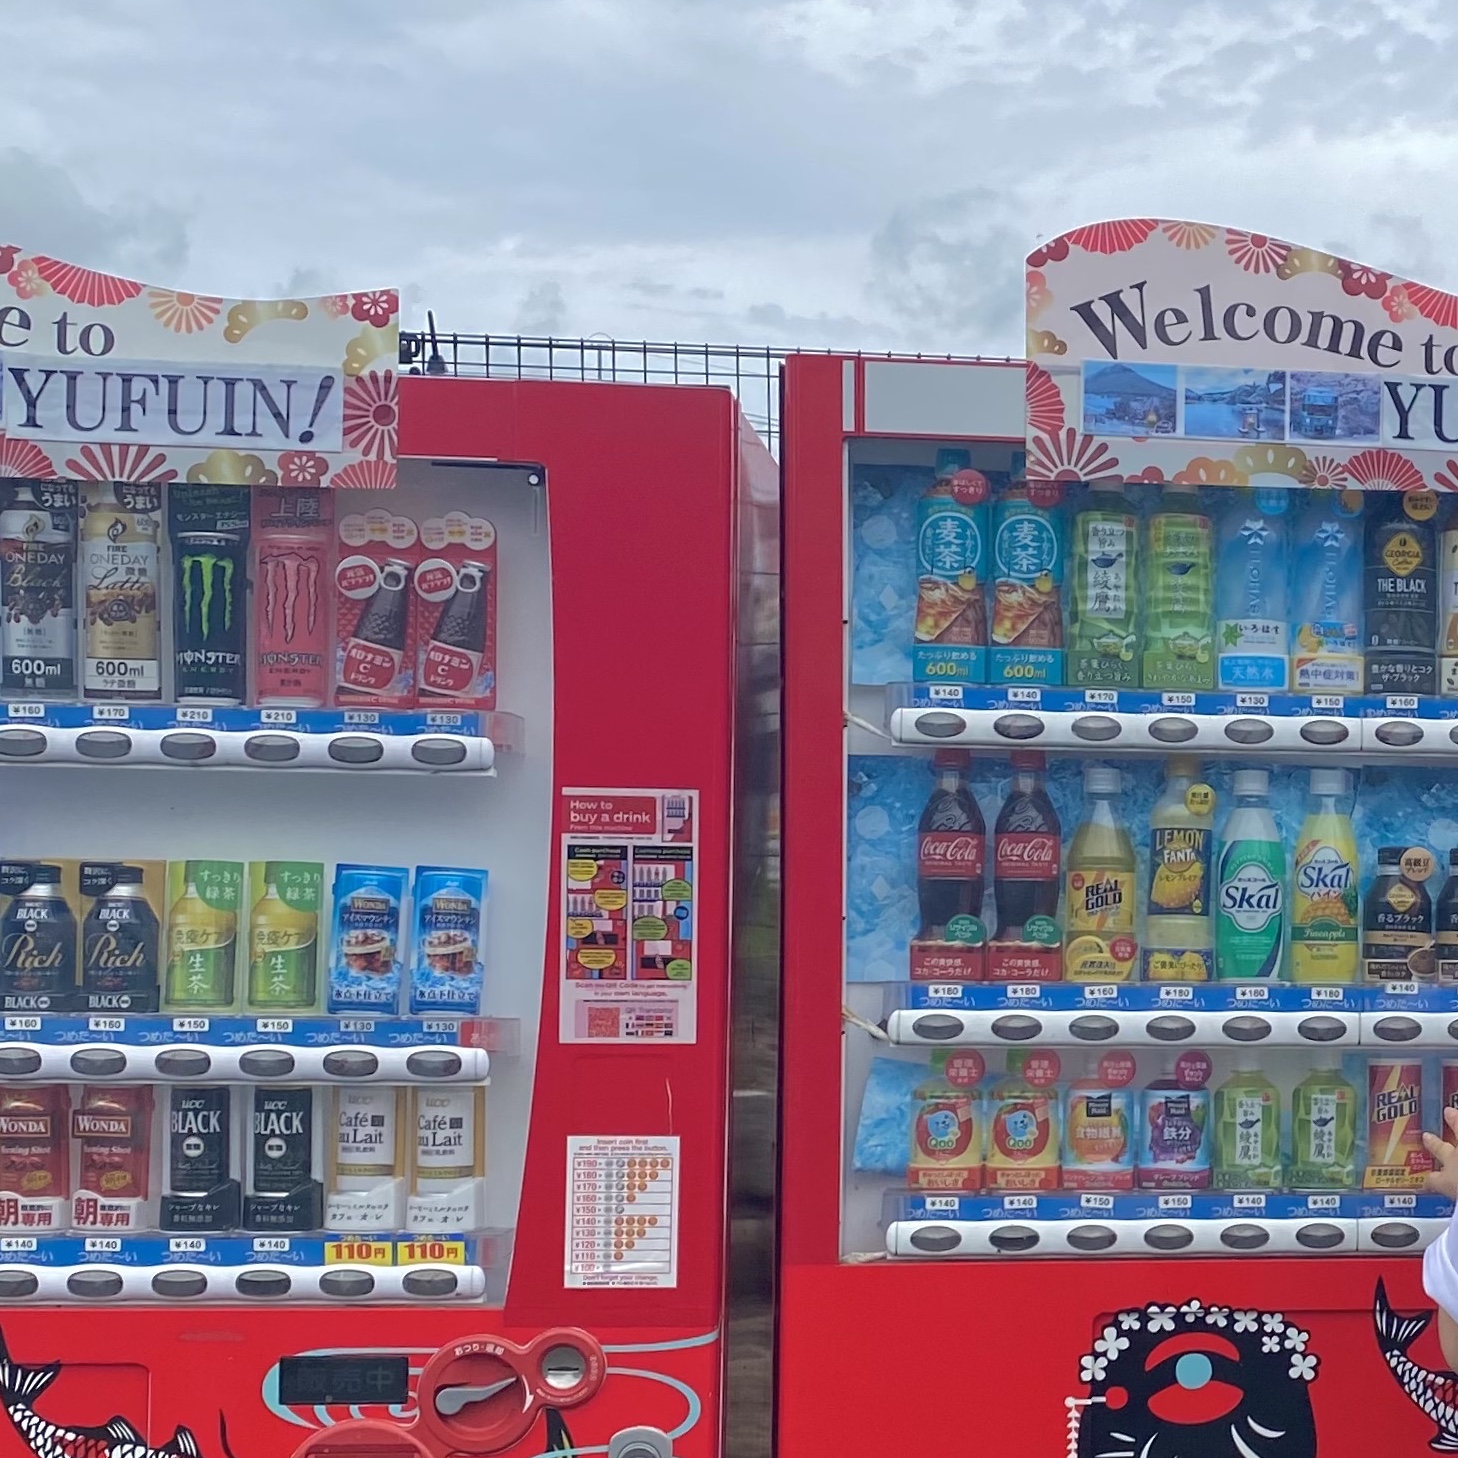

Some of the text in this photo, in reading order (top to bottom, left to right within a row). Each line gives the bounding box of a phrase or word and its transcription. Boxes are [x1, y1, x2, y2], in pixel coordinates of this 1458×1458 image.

[1069, 279, 1404, 370] Welcome
[52, 311, 116, 357] to
[7, 367, 336, 445] YUFUIN!
[935, 518, 964, 570] 麦茶
[1011, 521, 1040, 573] 麦茶
[5, 551, 66, 565] ONEDAY
[89, 553, 148, 566] ONEDAY
[87, 567, 150, 591] Latte
[1376, 578, 1427, 594] THE BLACK
[11, 659, 62, 676] 600ml
[95, 660, 145, 678] 600ml
[925, 662, 970, 677] 600ml
[1002, 664, 1047, 680] 600ml
[933, 688, 960, 697] ¥140
[1012, 690, 1038, 700] ¥140
[1088, 692, 1115, 702] ¥170
[1167, 695, 1192, 704] ¥150
[1239, 696, 1266, 706] ¥130
[1315, 697, 1341, 707] ¥150
[1390, 697, 1415, 707] ¥160
[97, 707, 126, 717] ¥170
[181, 710, 209, 720] ¥210
[264, 711, 293, 722] ¥210
[347, 713, 376, 723] ¥130
[430, 715, 459, 725] ¥130
[569, 799, 614, 811] How to
[570, 811, 652, 825] buy a drink
[1155, 828, 1204, 851] LEMON
[919, 834, 978, 862] Coca-Cola
[996, 835, 1054, 862] Coca-Cola
[1163, 849, 1198, 864] FANTA
[199, 869, 241, 884] すっきり
[205, 885, 236, 901] 緑茶
[1085, 877, 1122, 899] REAL
[1085, 891, 1123, 912] GOLD
[16, 907, 49, 920] BLACK
[98, 907, 130, 920] BLACK
[3, 932, 63, 969] Rich
[85, 932, 147, 969] Rich
[932, 986, 960, 996] ¥180
[1011, 986, 1037, 996] ¥180
[1088, 986, 1114, 997] ¥160
[1240, 988, 1265, 998] ¥180
[1315, 989, 1340, 999] ¥180
[1390, 983, 1416, 993] ¥140
[4, 995, 39, 1010] BLACK
[88, 994, 120, 1009] BLACK
[9, 1018, 38, 1029] ¥160
[177, 1019, 206, 1030] ¥150
[261, 1020, 290, 1031] ¥150
[343, 1021, 372, 1031] ¥130
[426, 1022, 455, 1032] ¥130
[1375, 1083, 1418, 1110] REAL
[1376, 1100, 1418, 1124] GOLD
[77, 1116, 128, 1134] WONDA
[171, 1110, 222, 1134] BLACK
[254, 1111, 304, 1135] BLACK
[338, 1110, 369, 1128] Café
[417, 1113, 447, 1130] Café
[351, 1129, 385, 1145] Lait
[430, 1131, 464, 1148] Lait
[928, 1137, 955, 1149] Qoo
[1006, 1137, 1033, 1149] Qoo
[929, 1198, 956, 1208] ¥140
[1008, 1197, 1034, 1207] ¥140
[1084, 1196, 1111, 1207] ¥150
[1163, 1197, 1189, 1206] ¥150
[1237, 1196, 1263, 1206] ¥140
[1311, 1197, 1337, 1206] ¥140
[1388, 1196, 1414, 1206] ¥140
[4, 1239, 34, 1249] ¥140
[89, 1240, 118, 1250] ¥140
[174, 1240, 202, 1250] ¥140
[258, 1239, 286, 1250] ¥140
[330, 1242, 386, 1261] 110円
[403, 1242, 459, 1260] 110円
